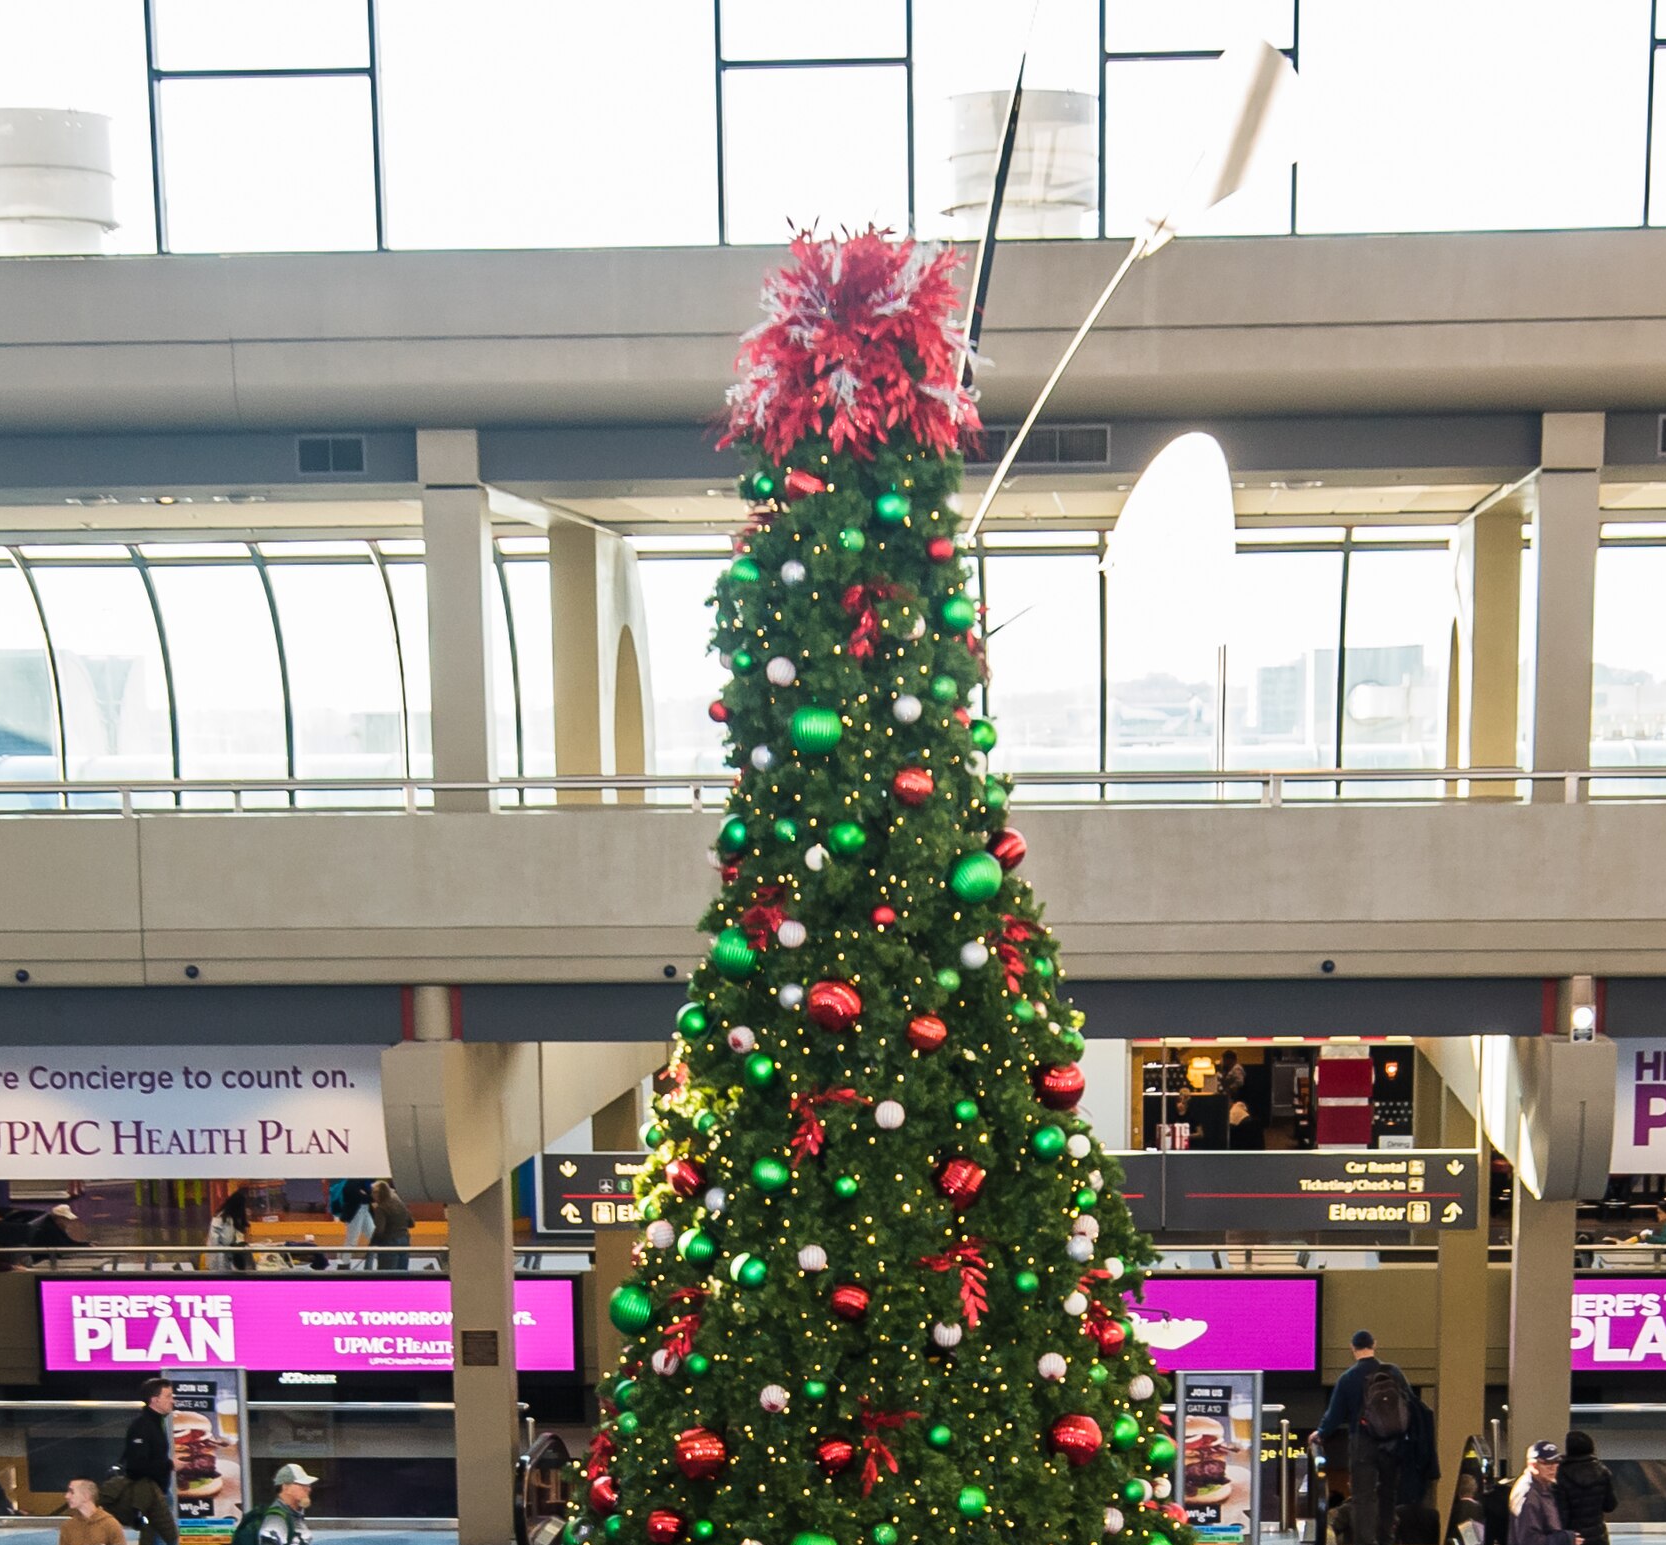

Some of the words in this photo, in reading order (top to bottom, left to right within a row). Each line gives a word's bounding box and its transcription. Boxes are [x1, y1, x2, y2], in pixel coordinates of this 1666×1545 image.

[29, 1065, 174, 1094] Concierge
[183, 1066, 213, 1089] to
[222, 1065, 302, 1089] count
[312, 1069, 356, 1089] on.
[110, 1120, 247, 1156] HEALTH
[258, 1119, 351, 1155] PLAN
[1345, 1161, 1367, 1174] Car
[1368, 1160, 1407, 1174] Rental
[1328, 1203, 1406, 1221] Elevator
[72, 1295, 173, 1318] HERE'S
[174, 1294, 233, 1318] THE
[299, 1311, 358, 1326] TODAY.
[73, 1317, 236, 1363] PLAN
[334, 1337, 394, 1354] UPMC
[176, 1384, 197, 1393] JOIN
[197, 1384, 210, 1393] US
[1190, 1388, 1210, 1397] JOIN
[1211, 1388, 1224, 1398] US
[1187, 1404, 1206, 1414] GATE
